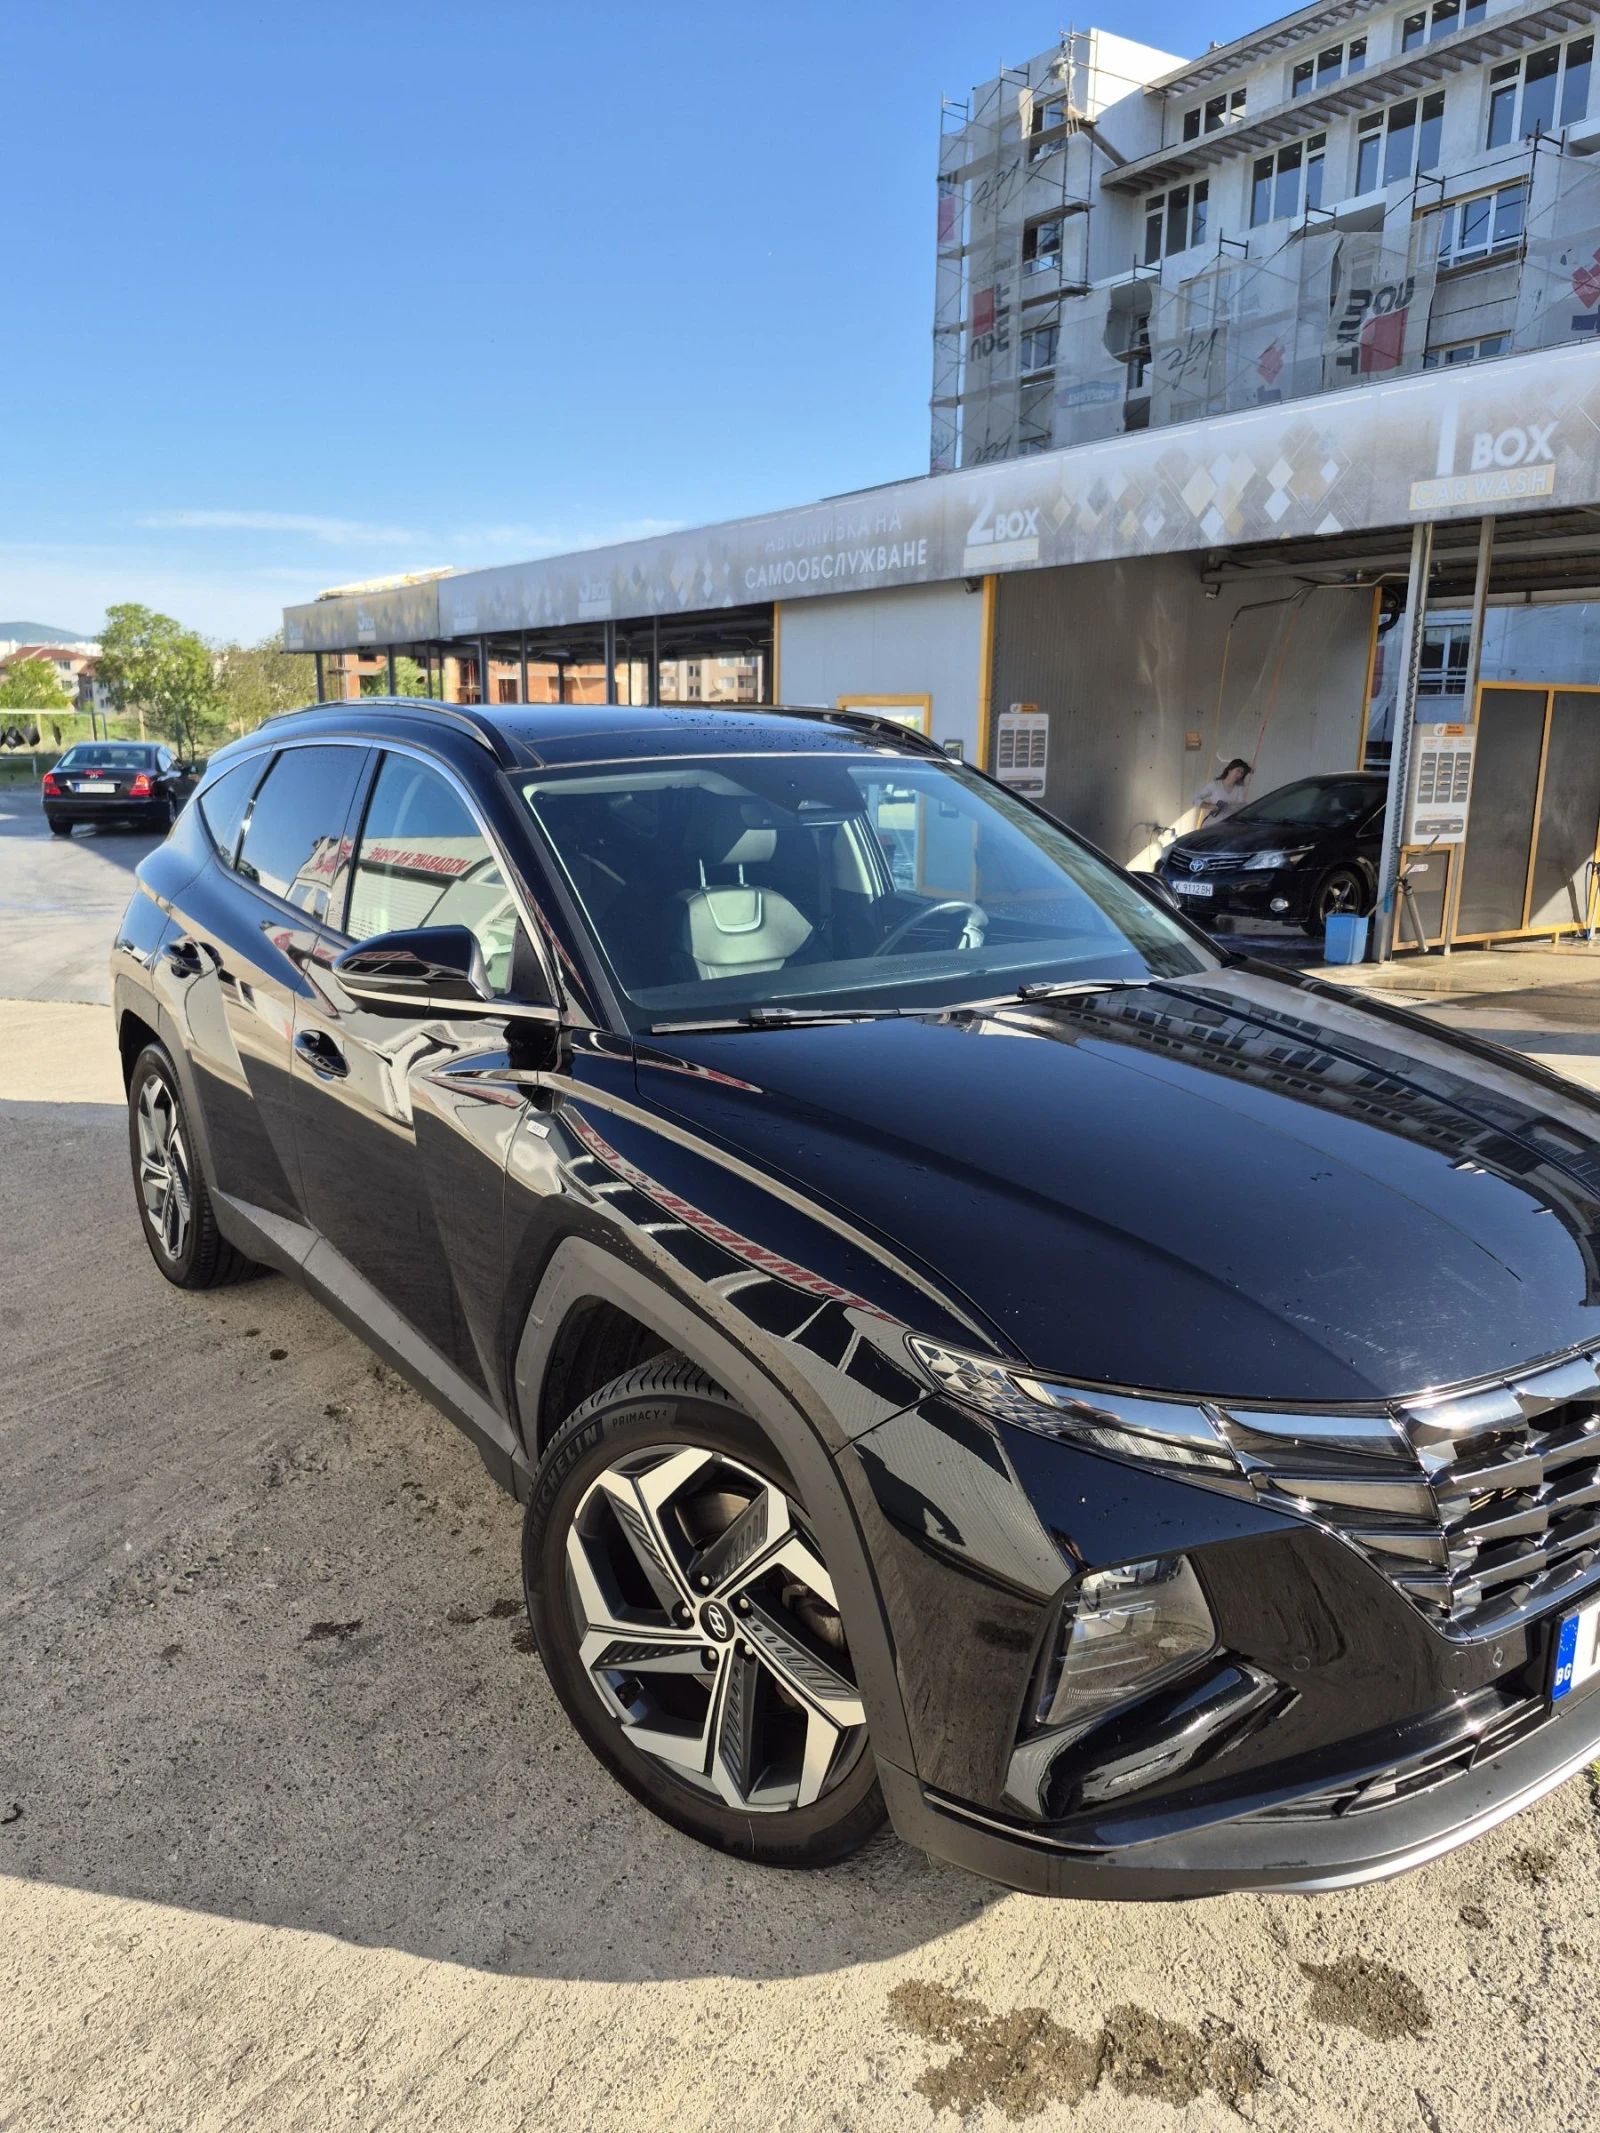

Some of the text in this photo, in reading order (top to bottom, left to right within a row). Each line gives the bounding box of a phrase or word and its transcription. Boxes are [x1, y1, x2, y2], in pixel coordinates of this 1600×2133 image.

[1471, 421, 1560, 471] BOX
[1415, 467, 1548, 506] CAR WASH
[875, 509, 902, 534] НА
[995, 507, 1040, 540] BOX
[744, 538, 928, 589] САМООБСЛУЖВАНЕ
[612, 1409, 660, 1428] PRIMACY
[529, 1422, 599, 1538] MICHELIN
[1555, 1663, 1572, 1687] BG
